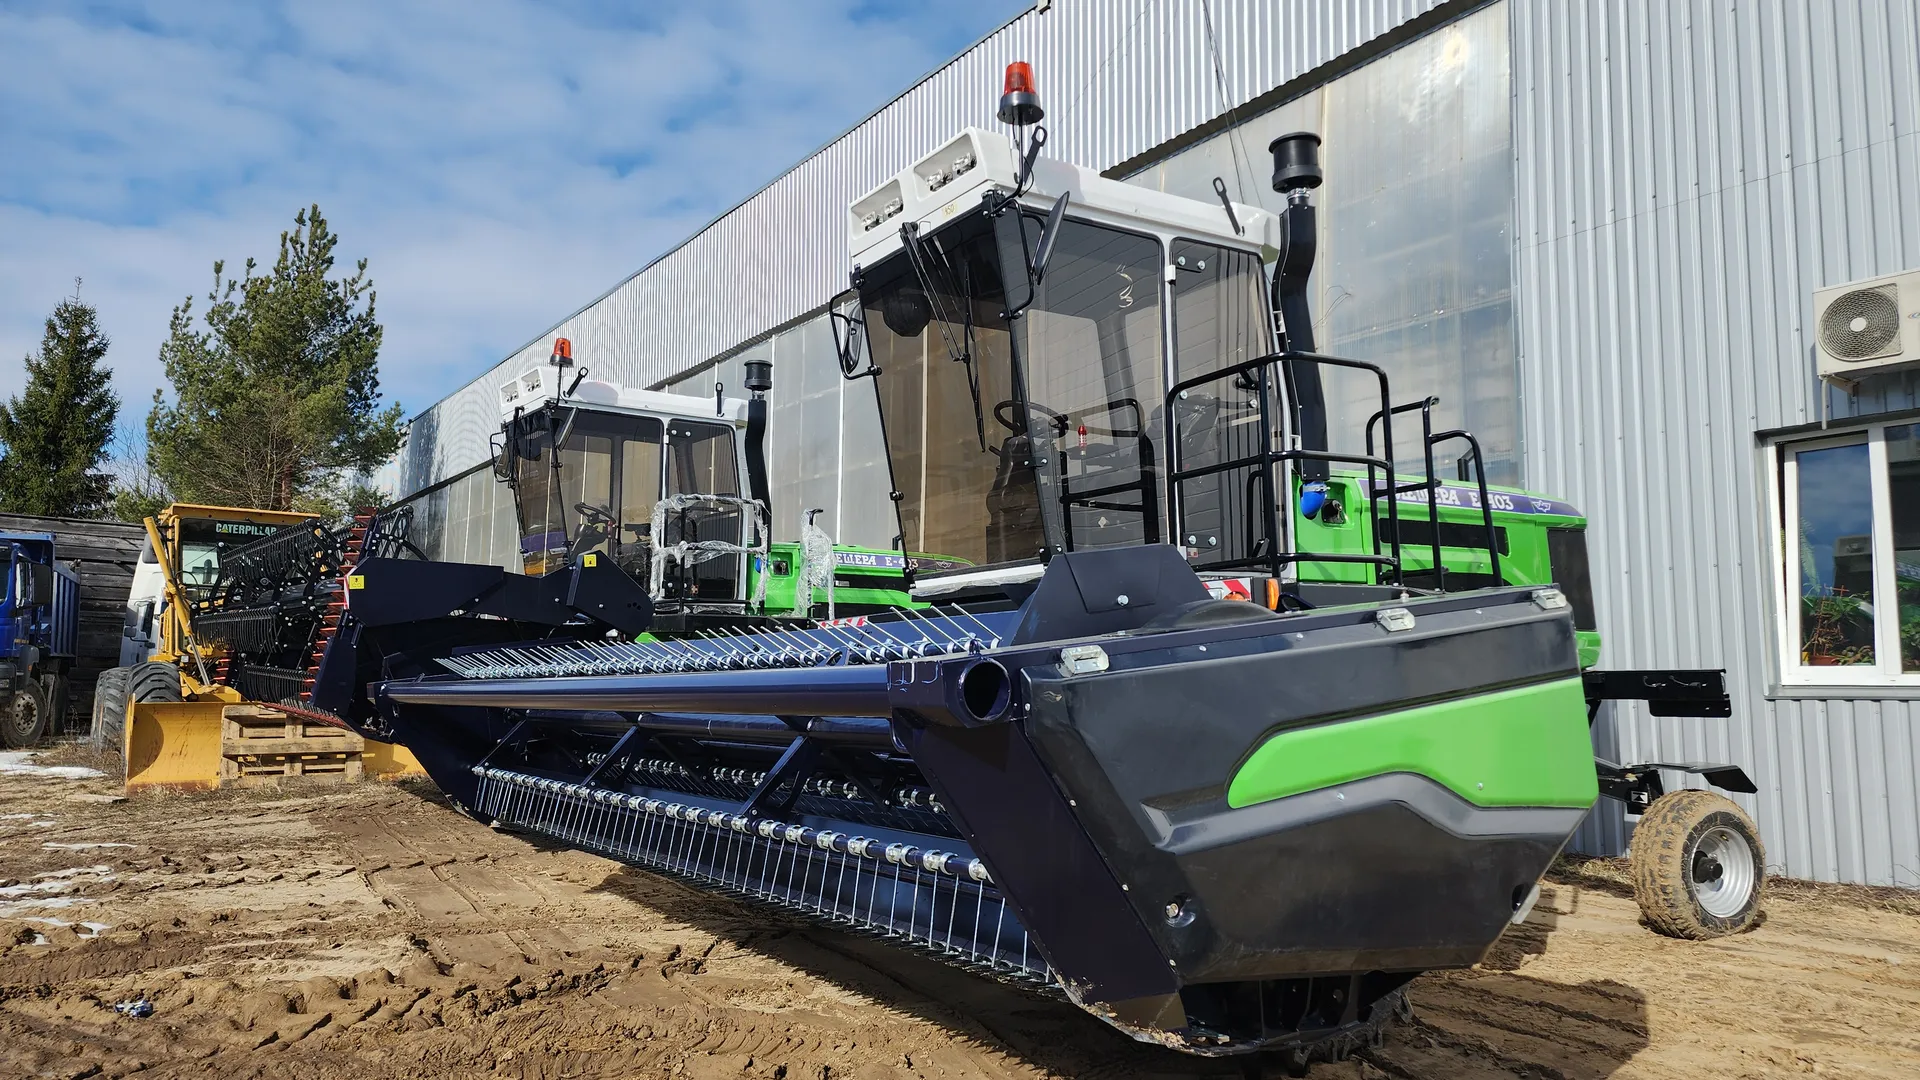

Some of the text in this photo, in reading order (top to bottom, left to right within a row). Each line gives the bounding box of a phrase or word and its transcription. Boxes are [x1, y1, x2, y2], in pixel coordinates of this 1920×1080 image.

[1395, 484, 1514, 510] ЕЩРА Е403
[215, 522, 277, 537] CATERPILLAR
[835, 552, 877, 565] ЕЩЕРА
